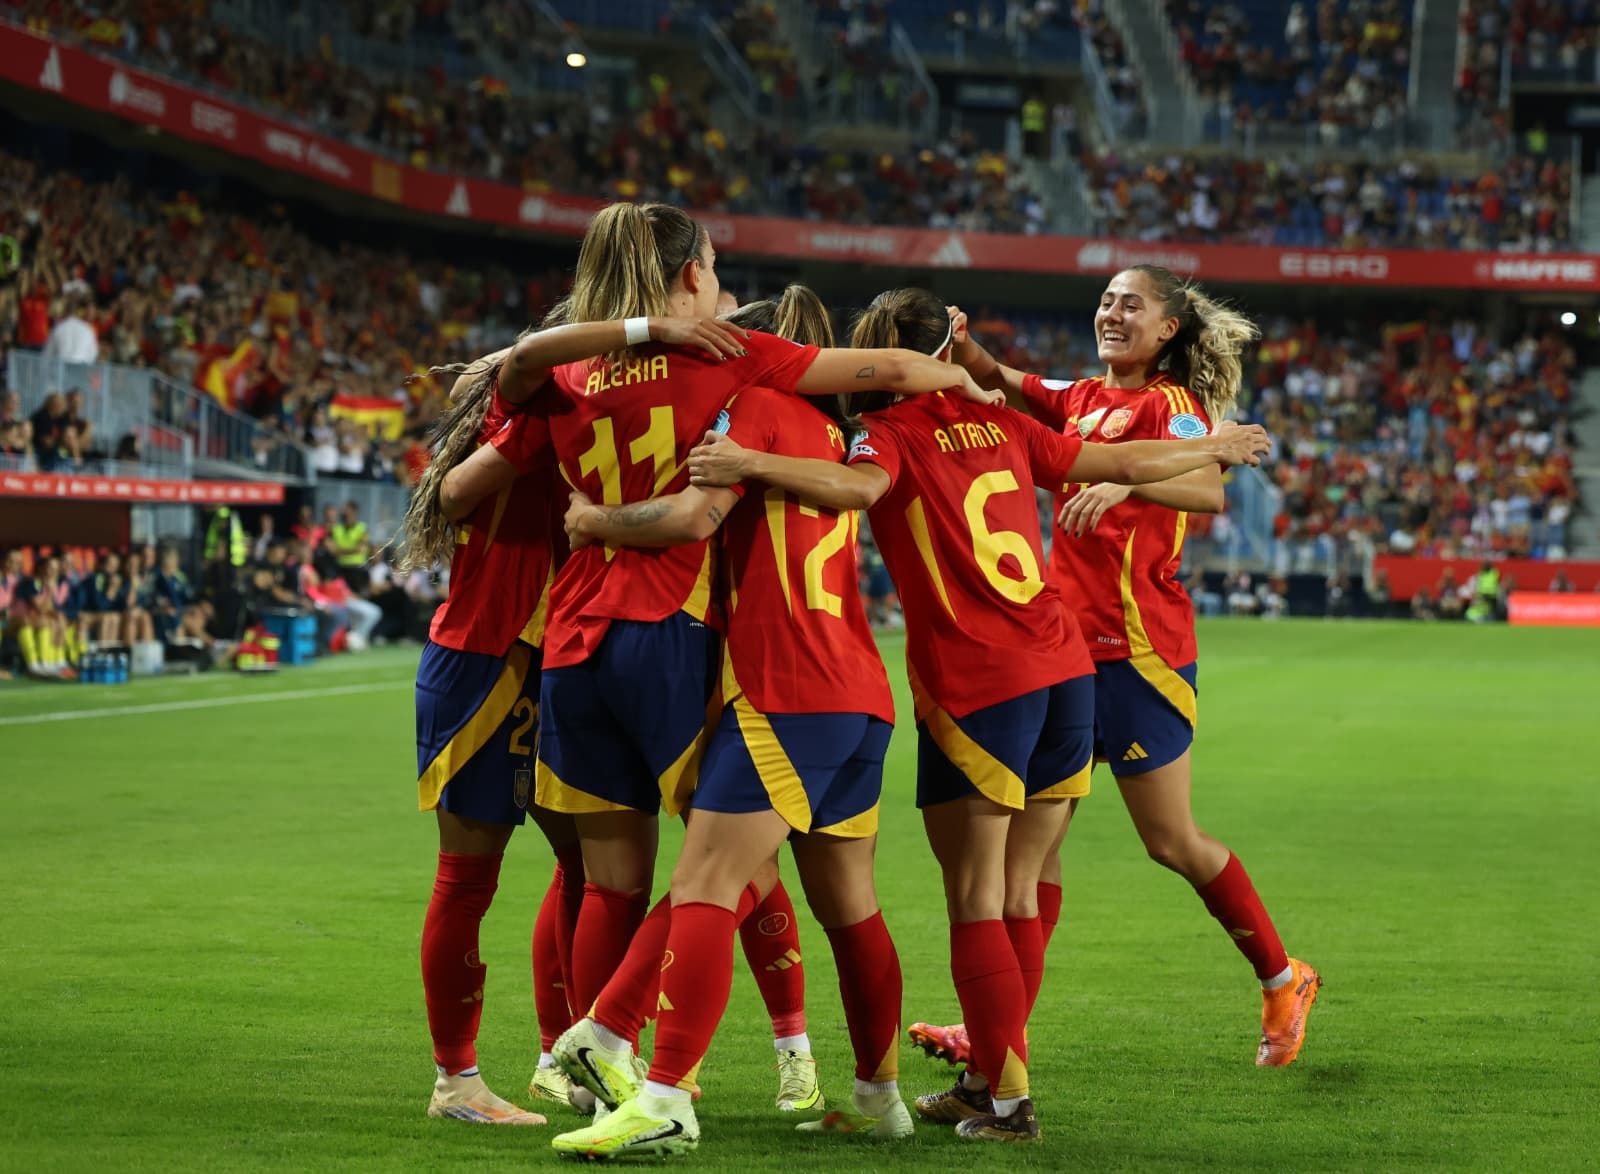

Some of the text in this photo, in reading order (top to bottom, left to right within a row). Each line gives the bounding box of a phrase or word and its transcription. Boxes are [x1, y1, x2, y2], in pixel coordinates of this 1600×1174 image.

[584, 355, 668, 396] ALEXIA
[934, 421, 1008, 453] AITANA
[579, 405, 677, 562] 11
[963, 469, 1045, 605] 6
